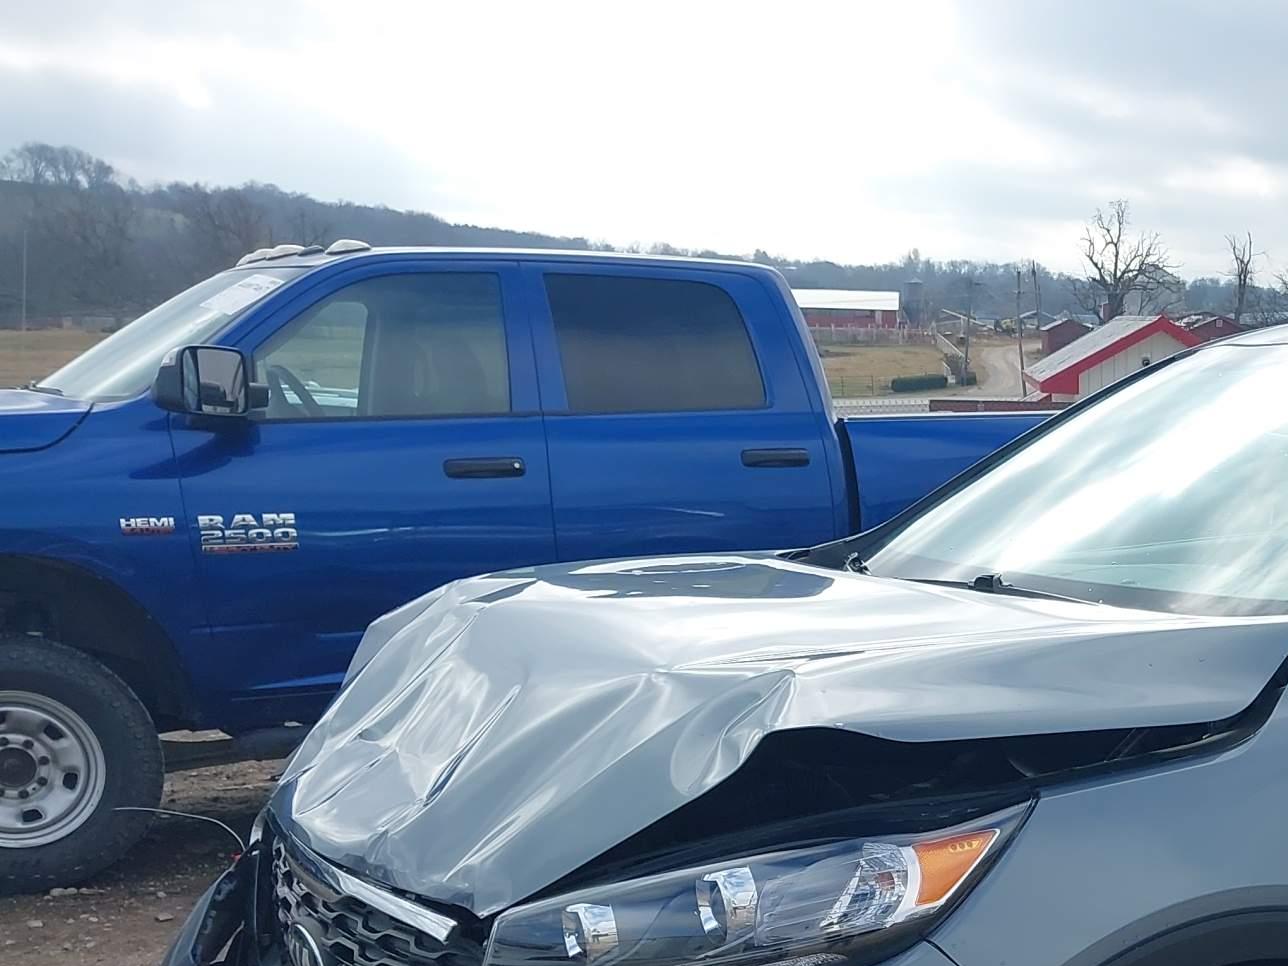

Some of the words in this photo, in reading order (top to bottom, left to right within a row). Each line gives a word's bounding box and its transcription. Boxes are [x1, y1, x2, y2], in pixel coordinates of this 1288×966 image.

[119, 517, 175, 528] HEMI
[197, 513, 296, 528] RAM
[200, 528, 297, 544] 2500
